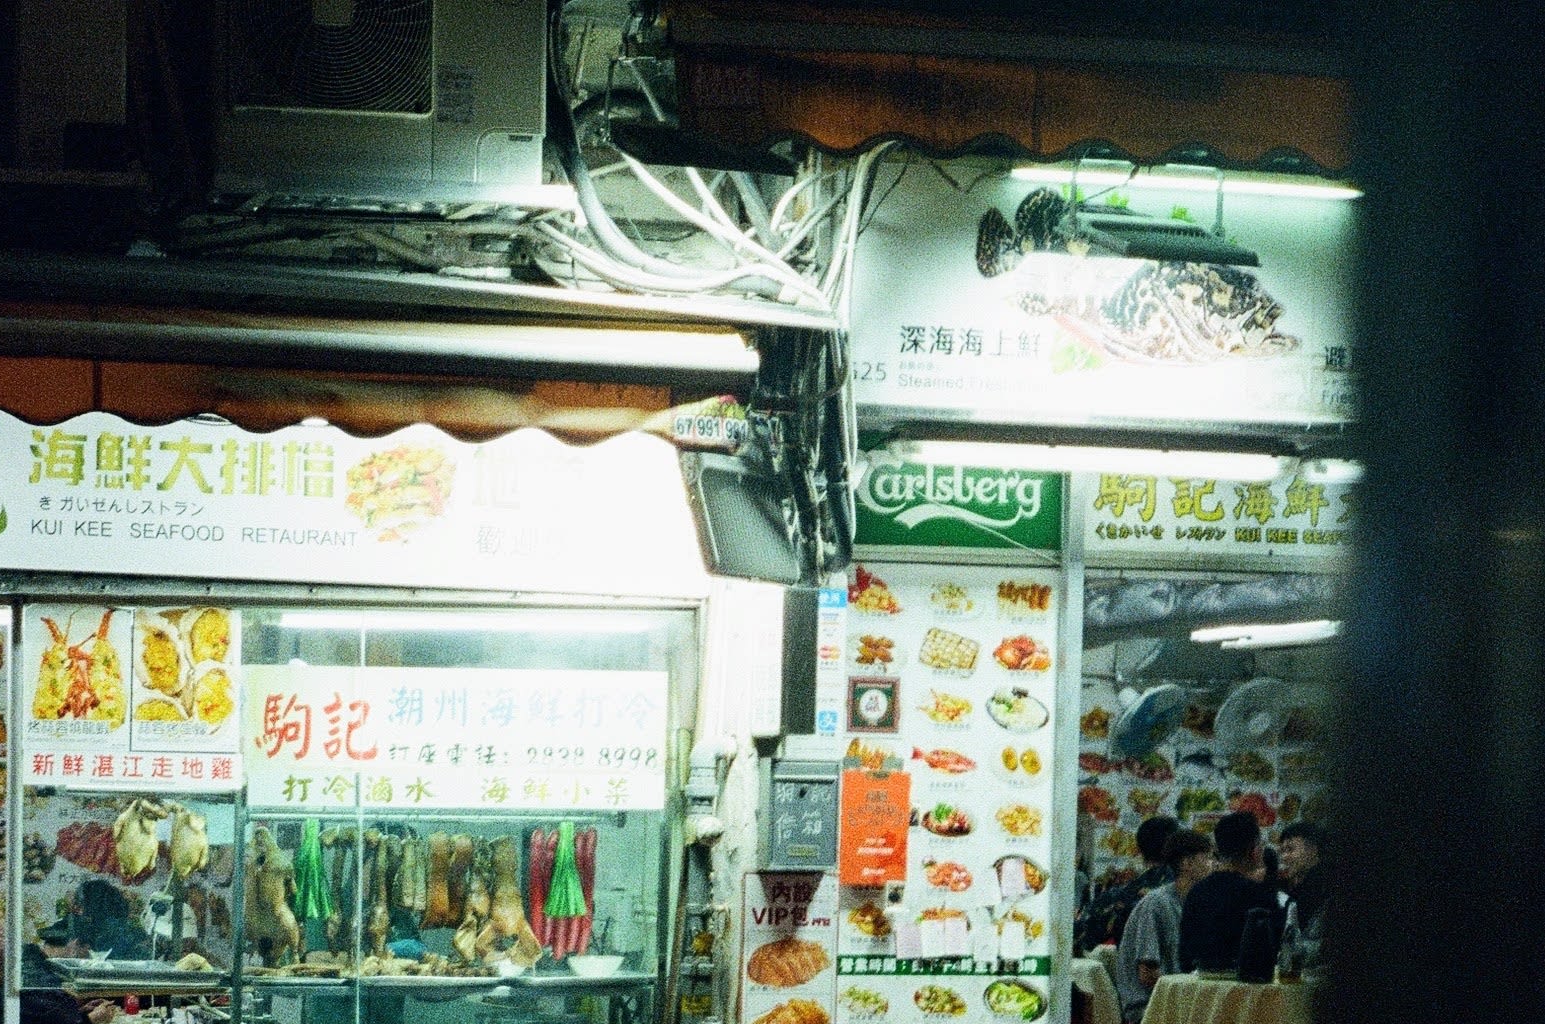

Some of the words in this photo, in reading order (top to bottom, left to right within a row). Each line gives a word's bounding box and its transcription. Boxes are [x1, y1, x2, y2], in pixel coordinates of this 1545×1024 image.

[900, 325, 1042, 357] 深海海上鮮
[898, 373, 965, 389] Steamed
[856, 462, 1043, 526] Carlsberg
[30, 519, 64, 536] KUI
[74, 520, 113, 538] KEE
[129, 522, 225, 543] SEAFOOD
[1234, 526, 1263, 543] KUI
[1266, 527, 1298, 544] KEE
[255, 691, 379, 762] 駒記
[32, 753, 234, 779] 新鮮湛江走地雞
